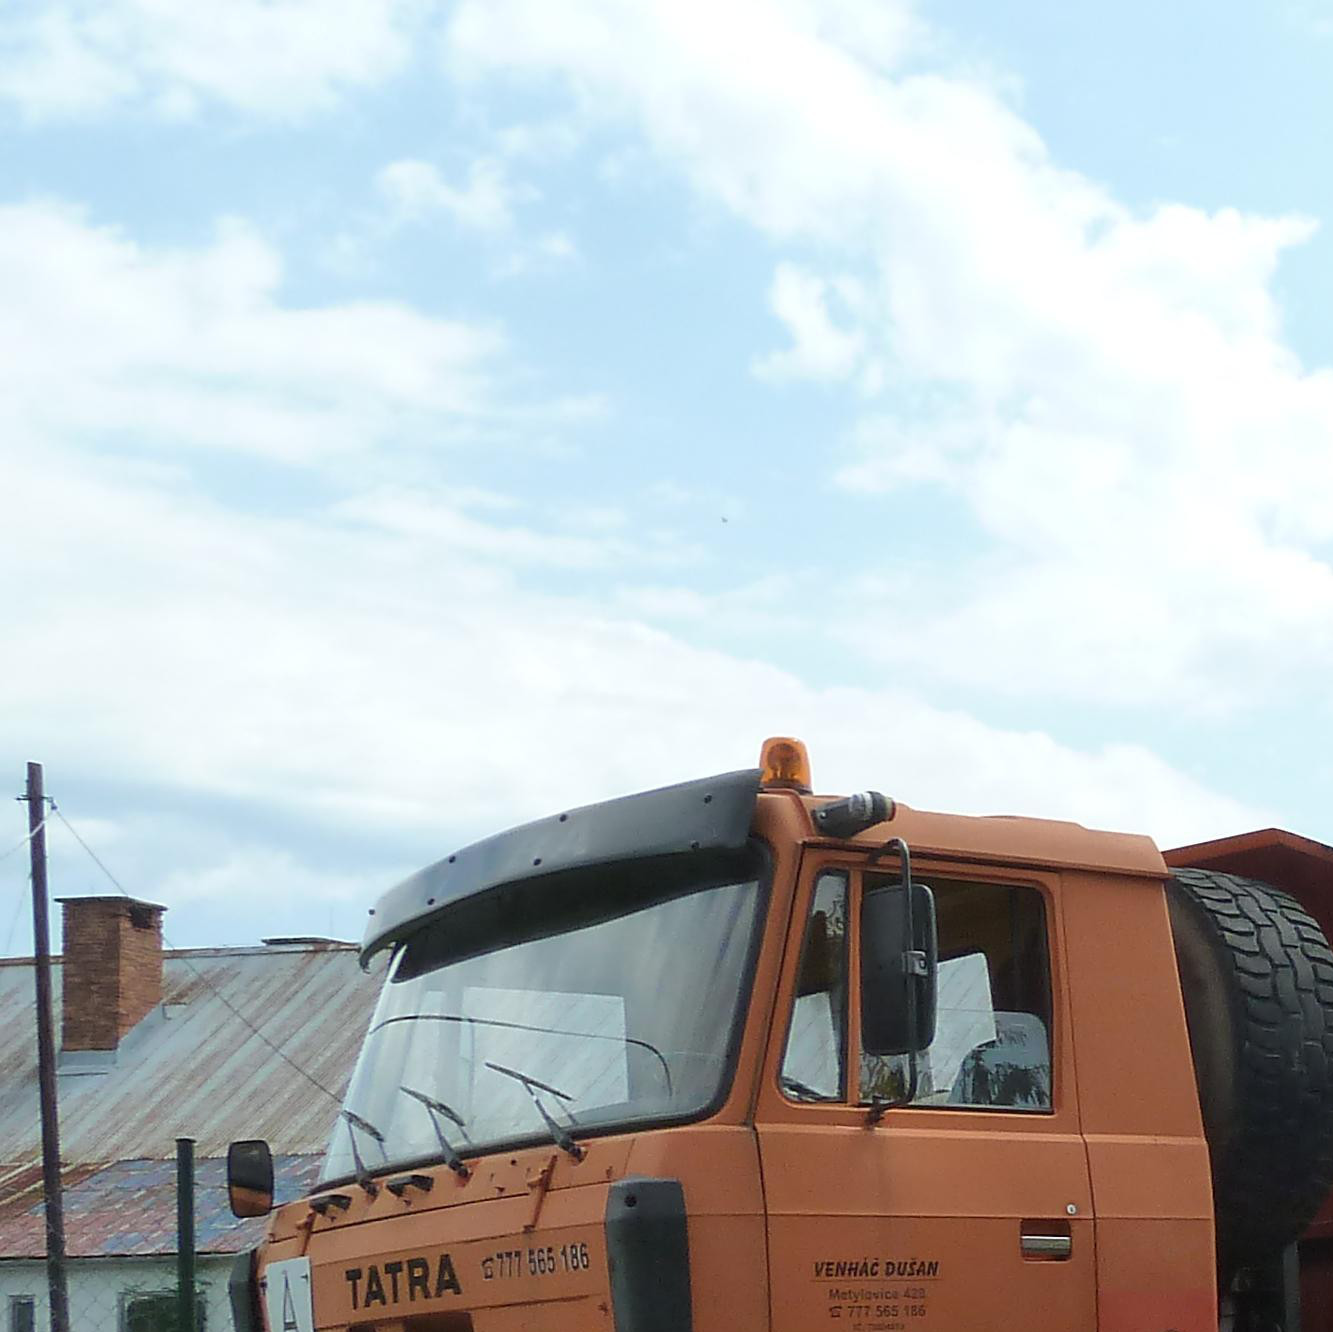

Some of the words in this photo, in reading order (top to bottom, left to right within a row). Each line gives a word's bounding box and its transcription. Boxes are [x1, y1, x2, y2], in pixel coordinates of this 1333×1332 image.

[345, 1253, 462, 1310] TATRA
[496, 1250, 522, 1280] 777
[528, 1246, 555, 1276] 565
[561, 1243, 590, 1272] 186
[814, 1256, 880, 1277] VENHÁČ
[885, 1256, 940, 1277] DUŠAN
[847, 1304, 871, 1318] 777
[875, 1304, 899, 1318] 565
[904, 1304, 926, 1318] 186
